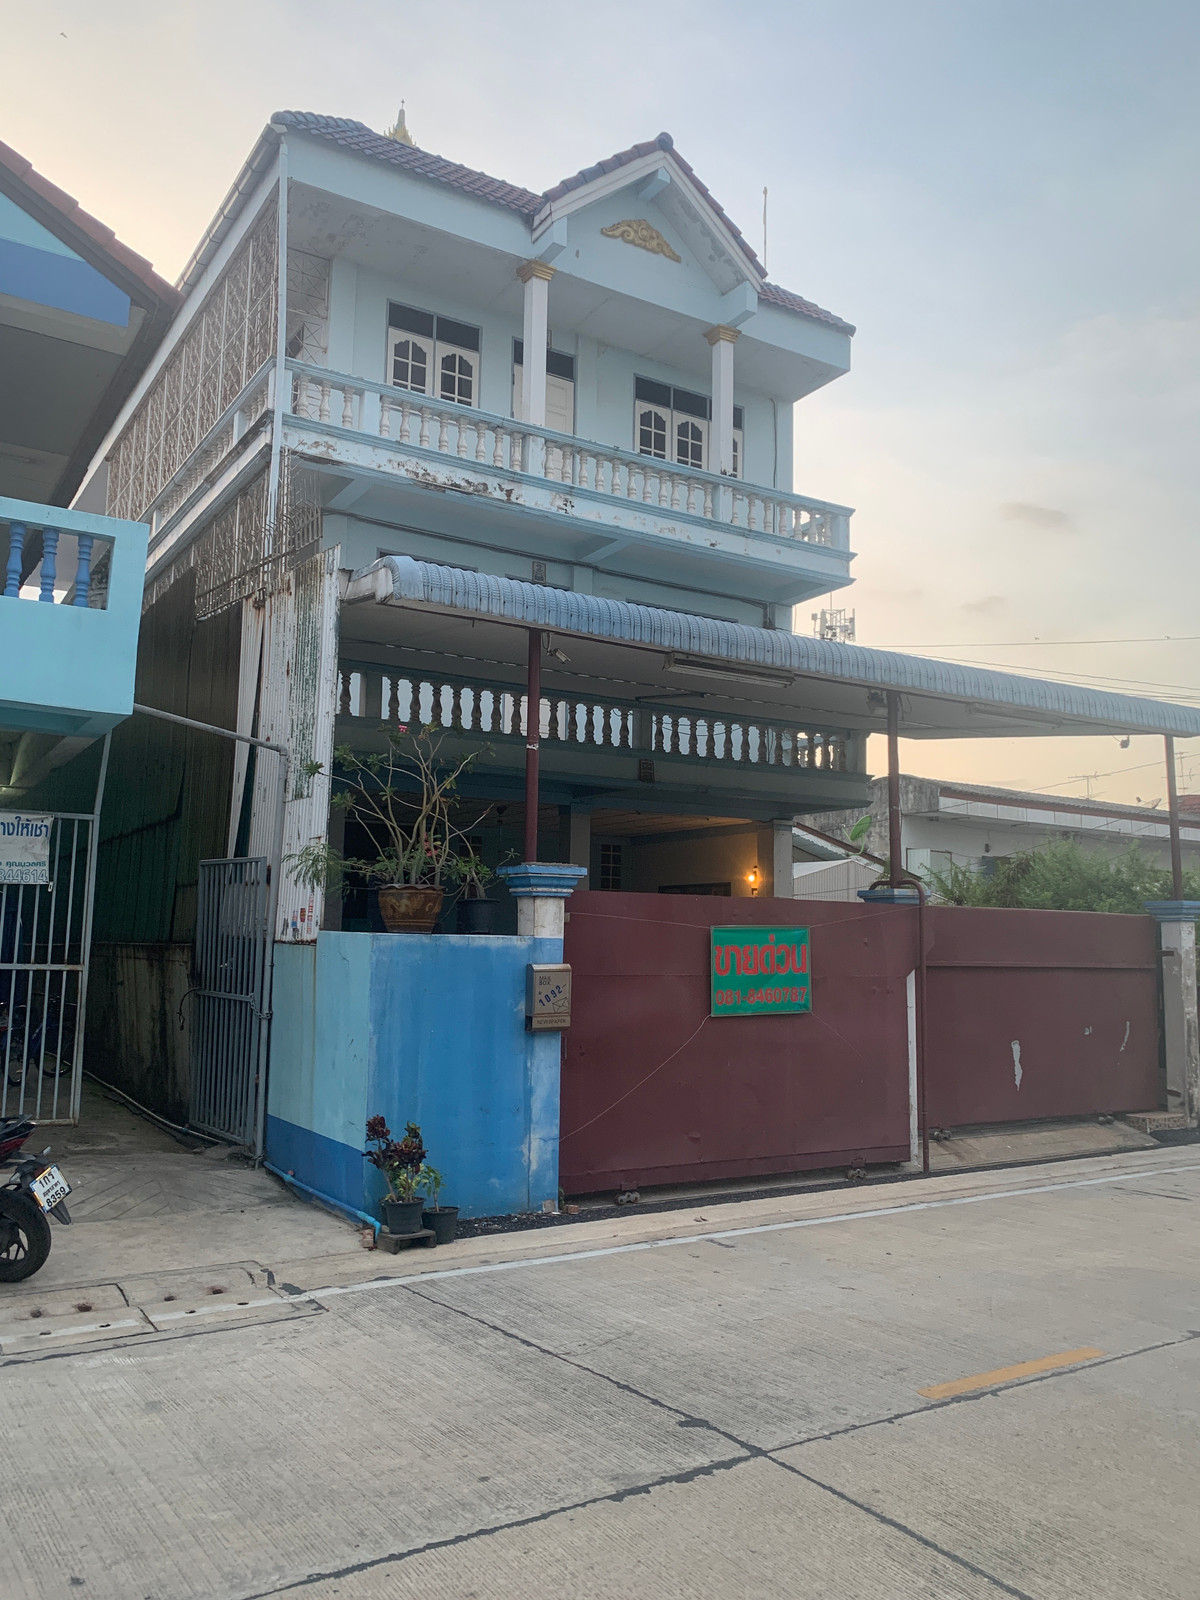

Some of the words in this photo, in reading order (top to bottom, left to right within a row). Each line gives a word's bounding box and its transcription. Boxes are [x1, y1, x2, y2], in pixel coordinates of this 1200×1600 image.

[714, 933, 808, 976] ขายด่วน
[539, 985, 562, 1006] 1092
[715, 986, 808, 1006] 081-8460787
[45, 1186, 66, 1207] 8359
